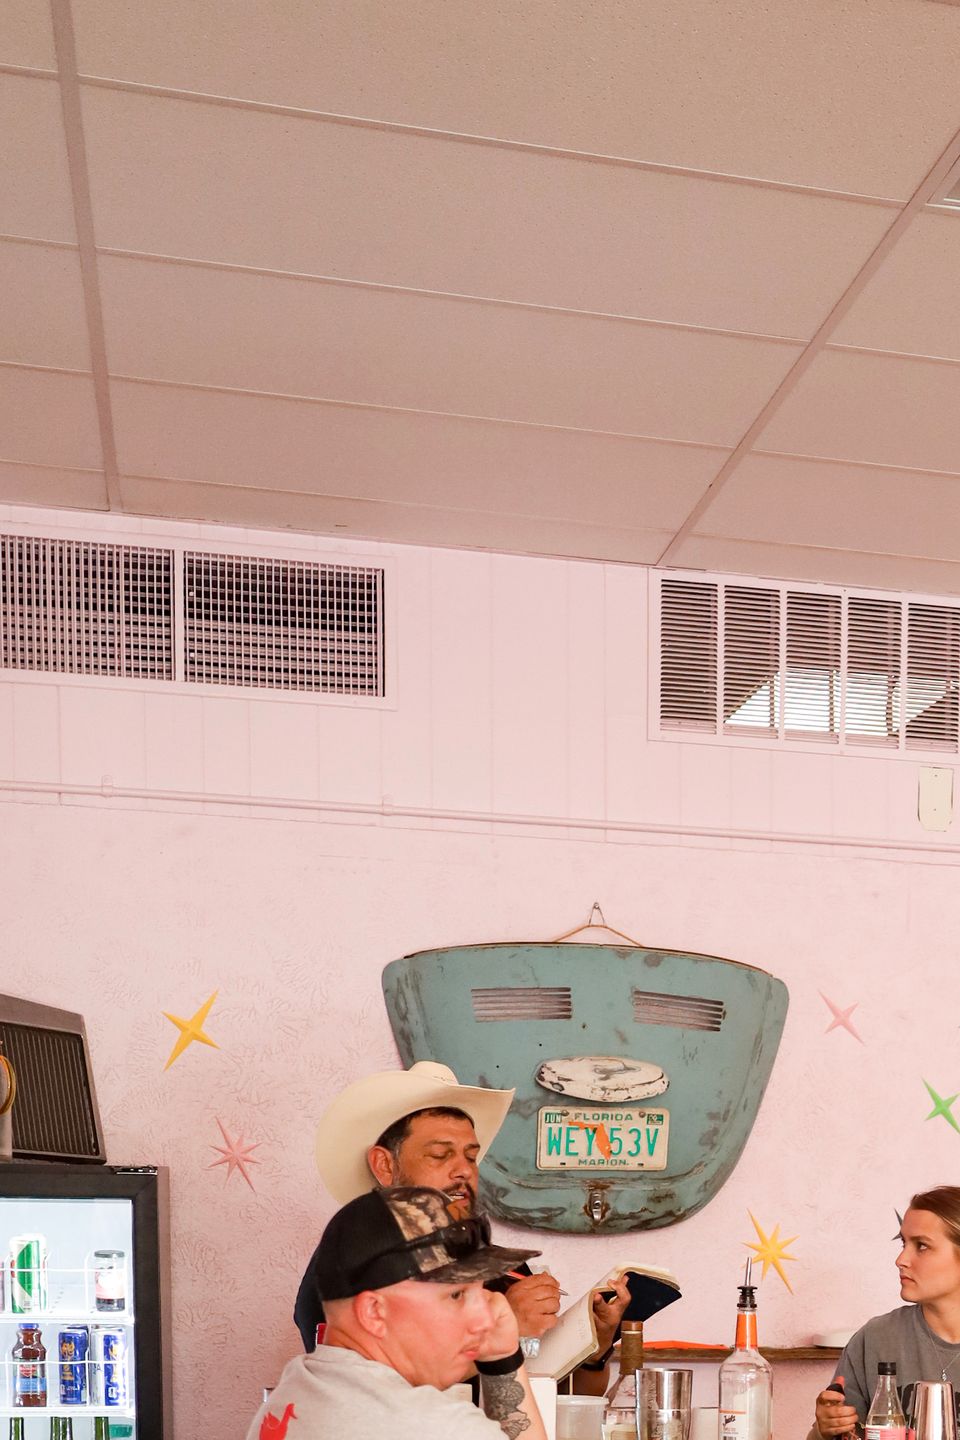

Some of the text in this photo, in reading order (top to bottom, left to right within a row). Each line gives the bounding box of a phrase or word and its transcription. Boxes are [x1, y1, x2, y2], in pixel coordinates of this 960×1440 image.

[545, 1112, 561, 1123] JUN
[574, 1113, 633, 1121] FLORIDA
[547, 1127, 659, 1157] WEY 53V
